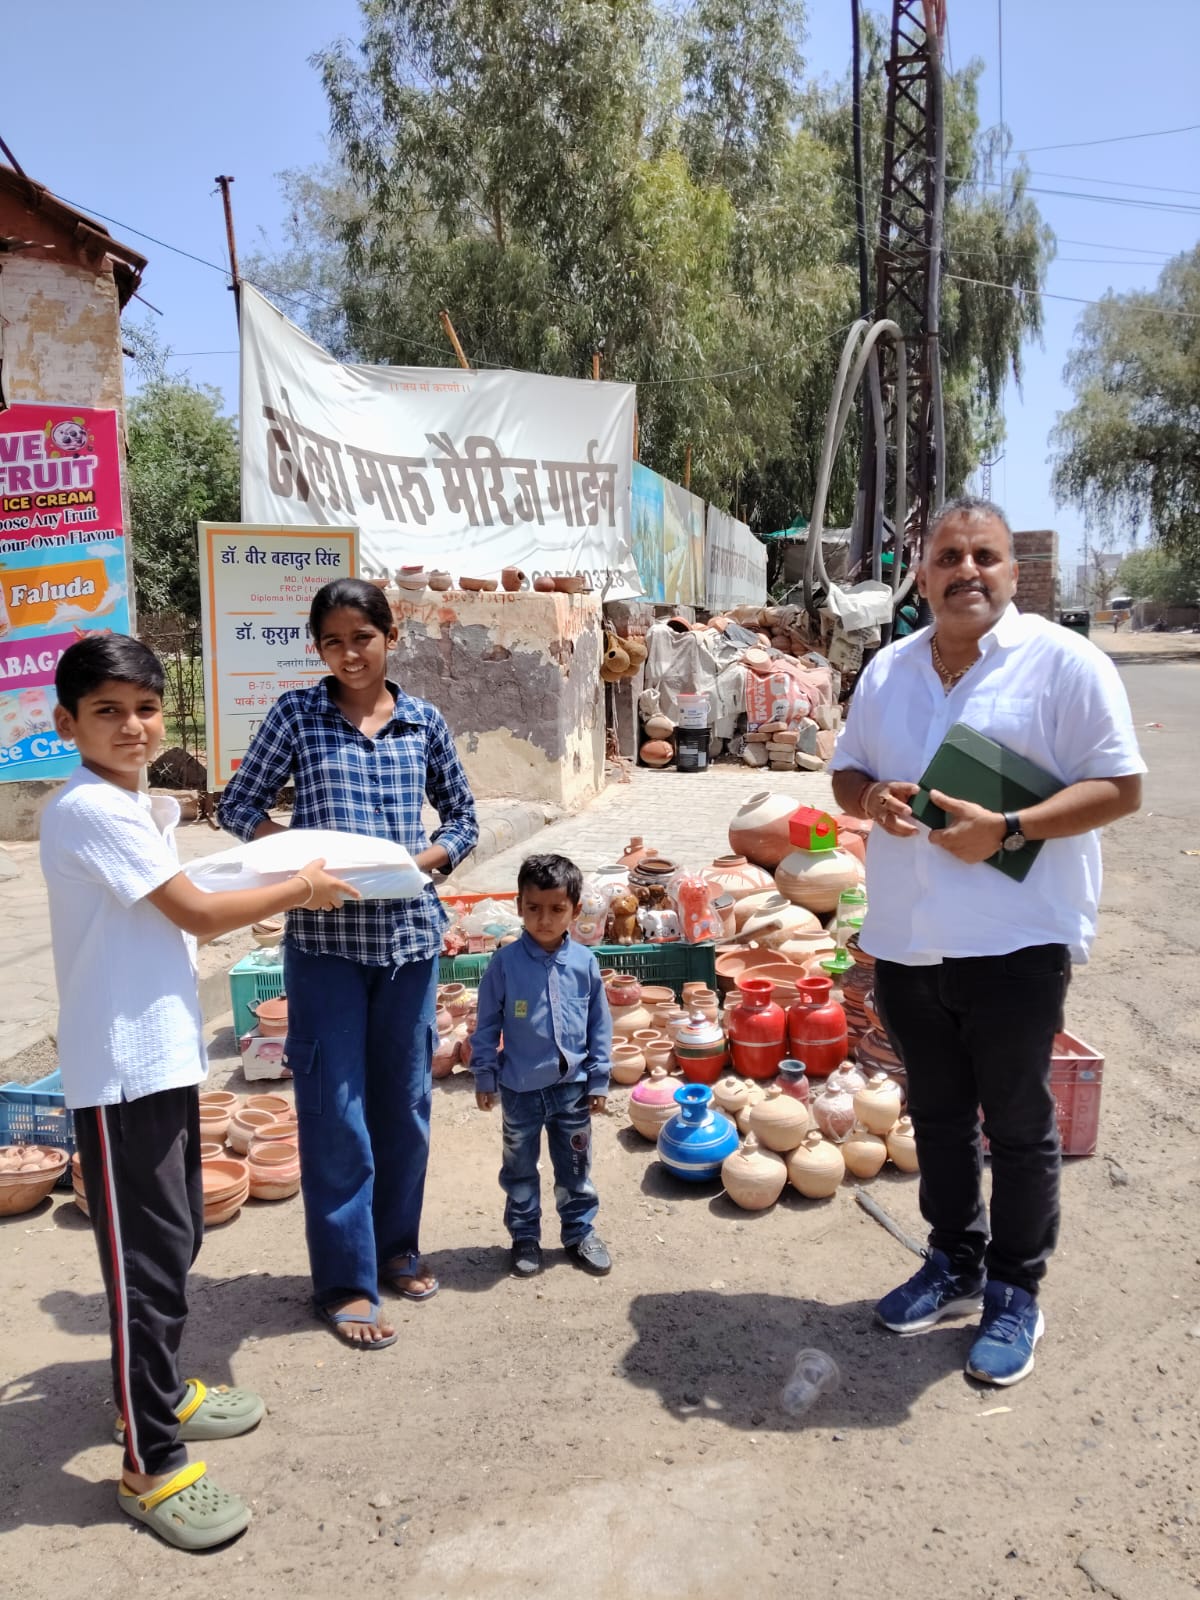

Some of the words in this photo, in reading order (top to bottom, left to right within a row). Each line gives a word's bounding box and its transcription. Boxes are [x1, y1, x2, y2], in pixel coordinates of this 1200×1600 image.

[425, 431, 546, 527] मैरिज
[541, 439, 619, 527] गार्डन
[3, 495, 31, 511] ICE
[35, 490, 94, 507] CREAM
[31, 511, 61, 530] Any
[64, 507, 98, 523] Fruit
[31, 534, 66, 550] Own
[69, 528, 116, 545] Flavou
[221, 545, 240, 564] डॉ.
[245, 545, 267, 565] वीर
[271, 550, 311, 570] बहादुर
[315, 547, 341, 567] सिंह
[10, 576, 96, 607] Faluda
[250, 593, 284, 604] Diploma
[279, 584, 303, 593] FRCP
[235, 622, 256, 640] डॉ.
[261, 627, 300, 645] कुसुम
